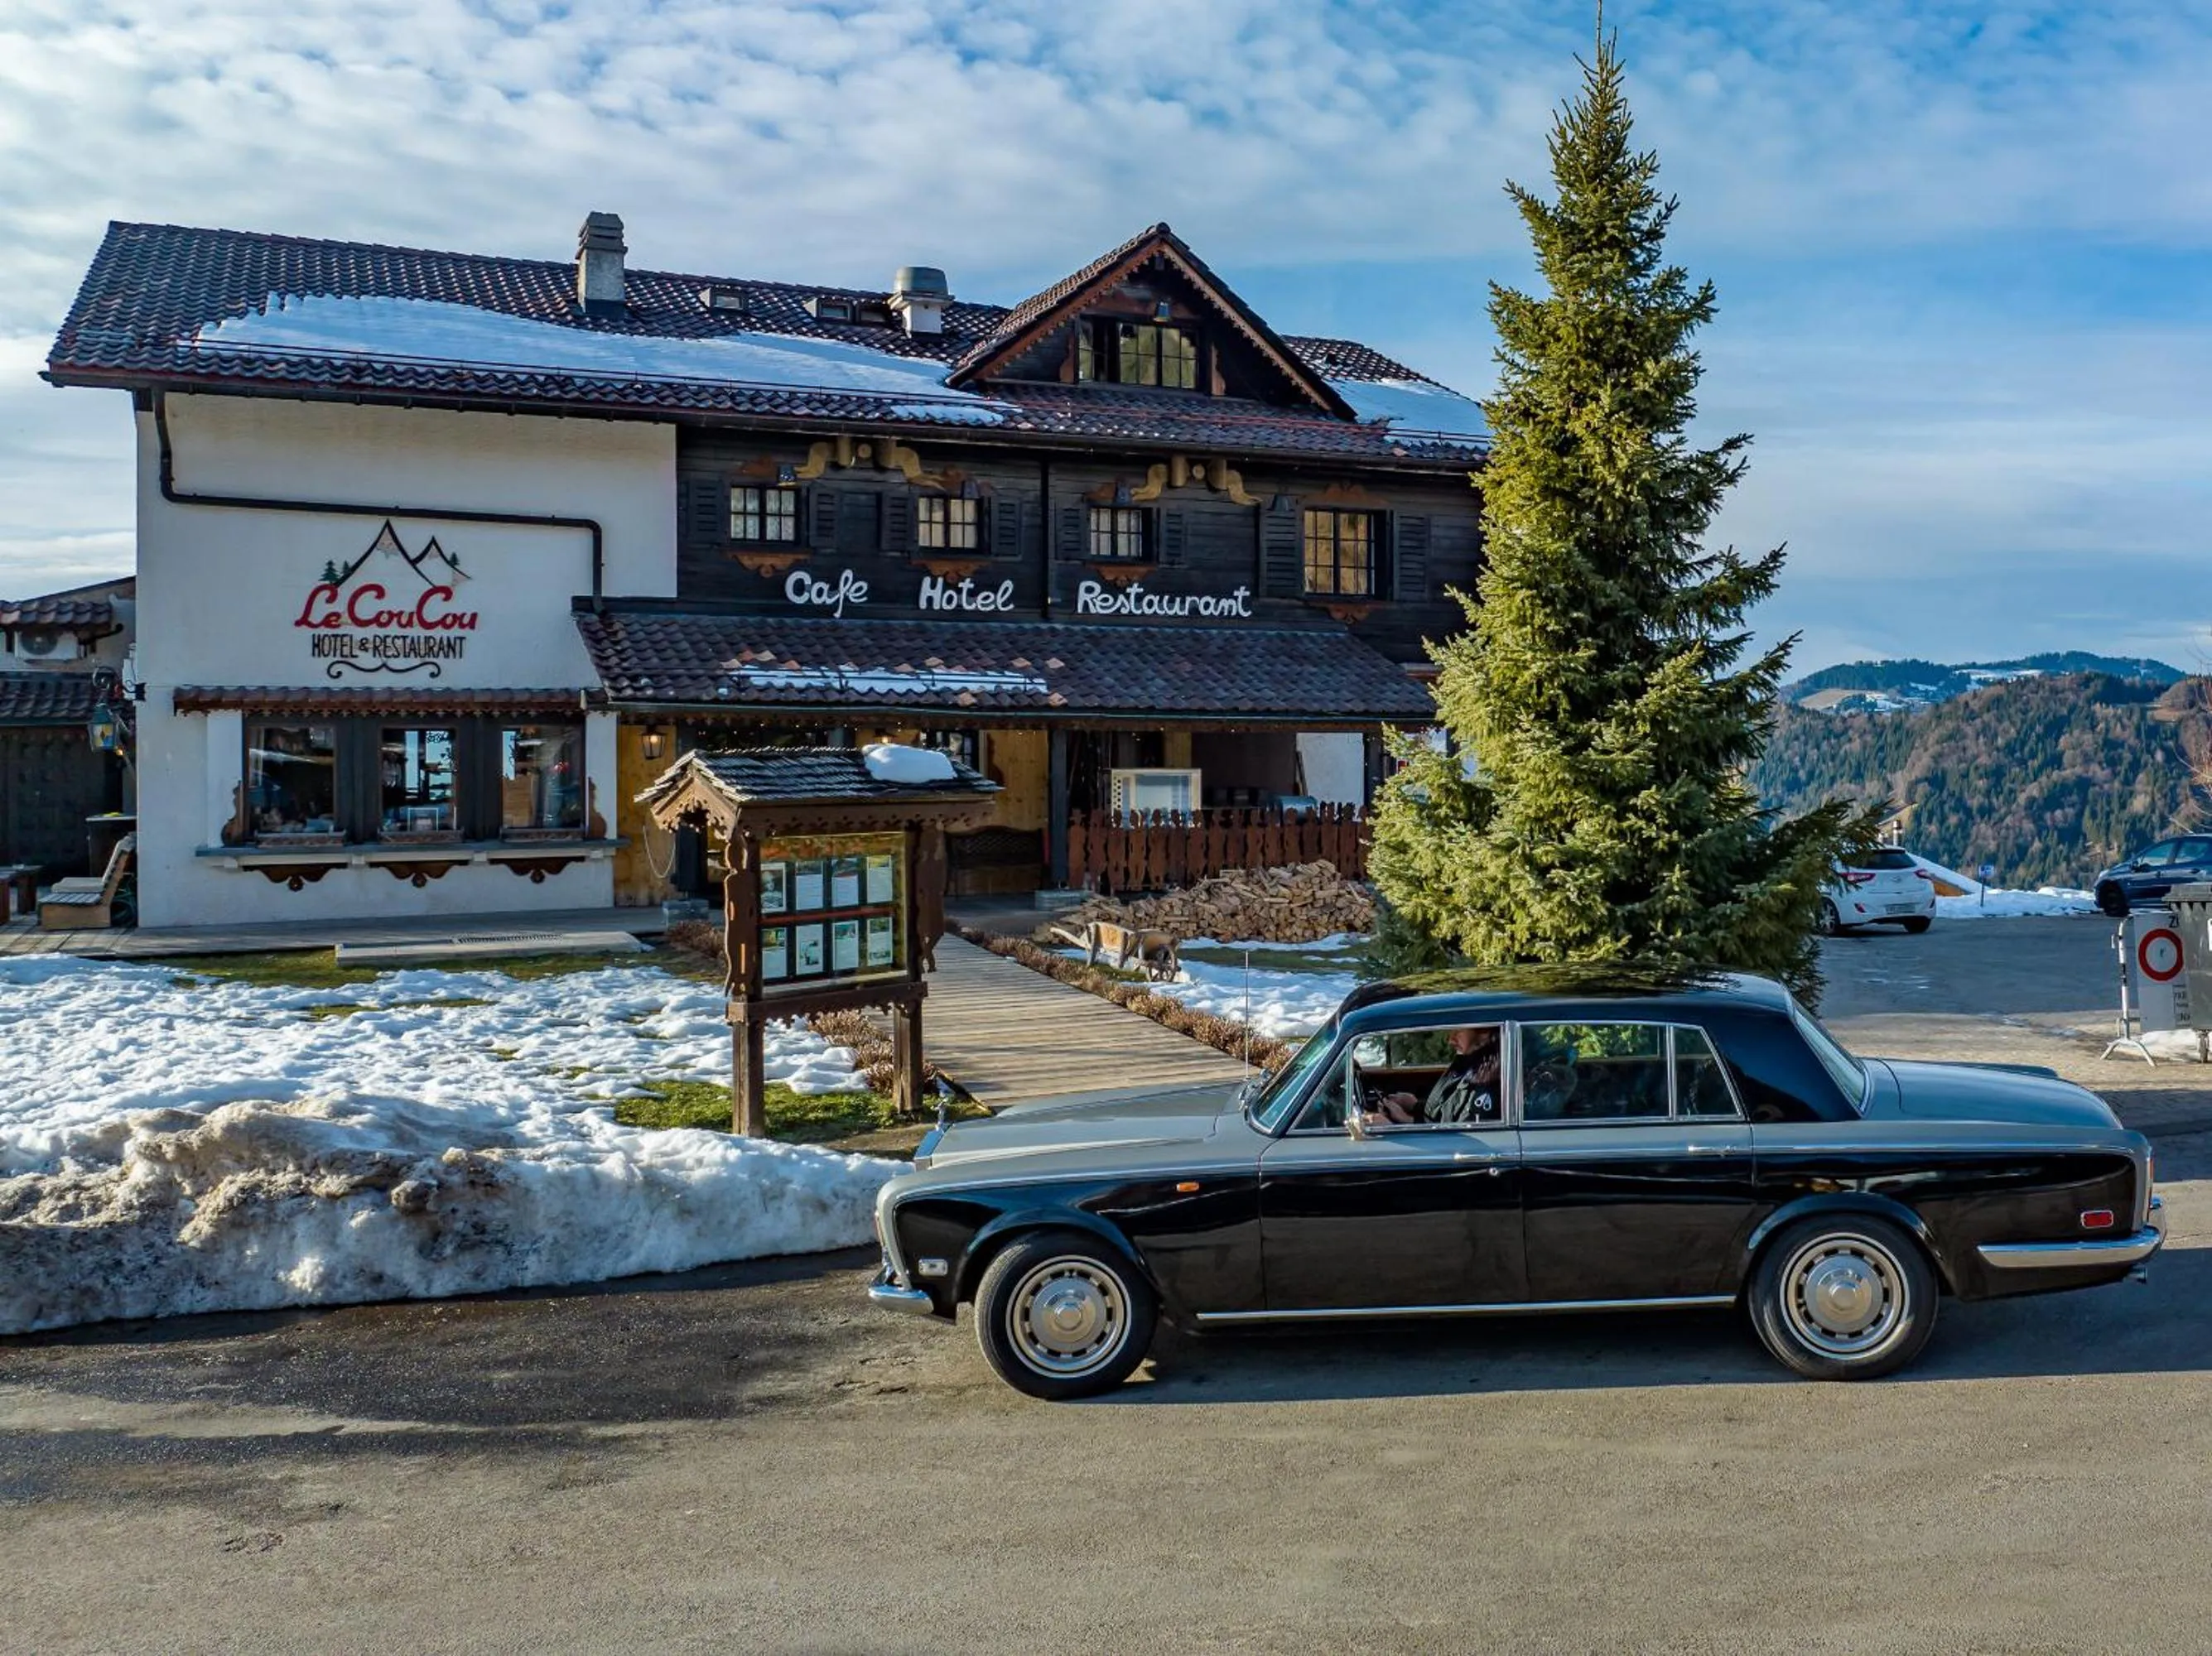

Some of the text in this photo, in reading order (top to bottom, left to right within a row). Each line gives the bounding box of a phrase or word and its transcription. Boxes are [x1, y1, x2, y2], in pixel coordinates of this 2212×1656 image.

[294, 583, 342, 629] Le
[784, 570, 1251, 618] Cafe Hotel Restaurant
[311, 633, 466, 659] HOTEL & RESTAURANT
